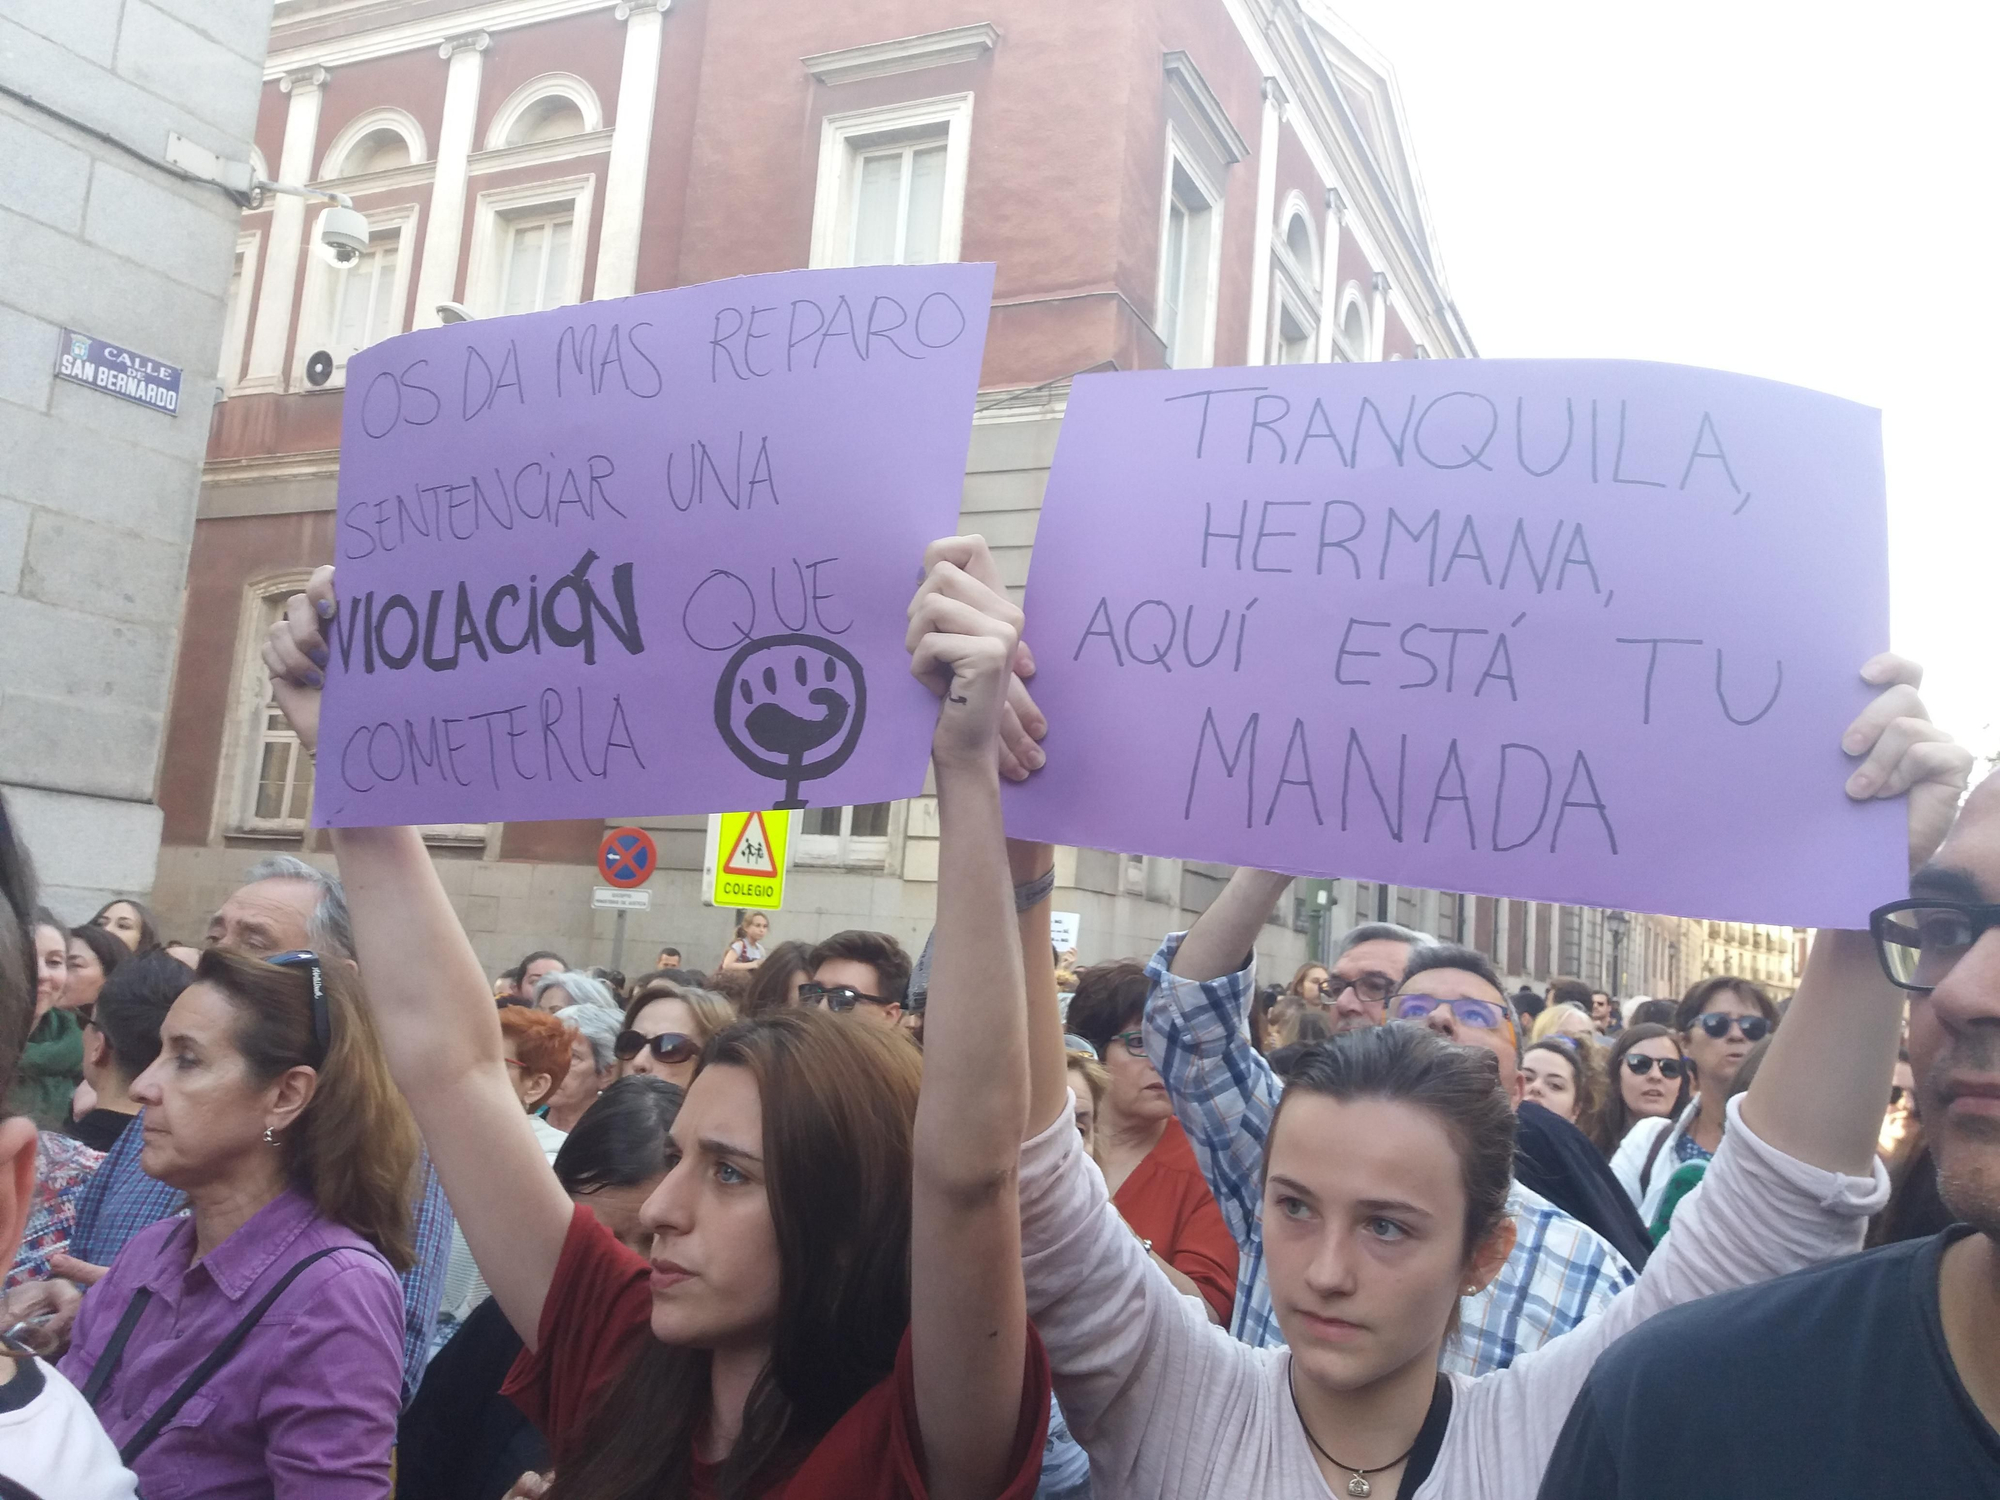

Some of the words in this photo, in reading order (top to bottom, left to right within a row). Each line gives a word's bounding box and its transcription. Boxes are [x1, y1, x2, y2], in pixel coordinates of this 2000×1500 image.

[60, 354, 96, 382] SAN
[96, 366, 177, 410] BERNARDO
[103, 347, 172, 381] CALLE
[126, 367, 146, 380] DE
[361, 359, 441, 439] OS
[464, 339, 525, 421] DA
[710, 292, 966, 383] REPARO
[667, 431, 780, 512] UNA
[1165, 386, 1752, 515] TRANQUILA,
[1202, 499, 1615, 608] HERMANA,
[683, 557, 855, 651] QUE
[1074, 597, 1258, 672] AQUÍ
[1335, 613, 1528, 702] ESTÁ
[1616, 636, 1782, 727] TU
[1185, 706, 1618, 856] MANADA
[723, 882, 775, 898] COLEGIO
